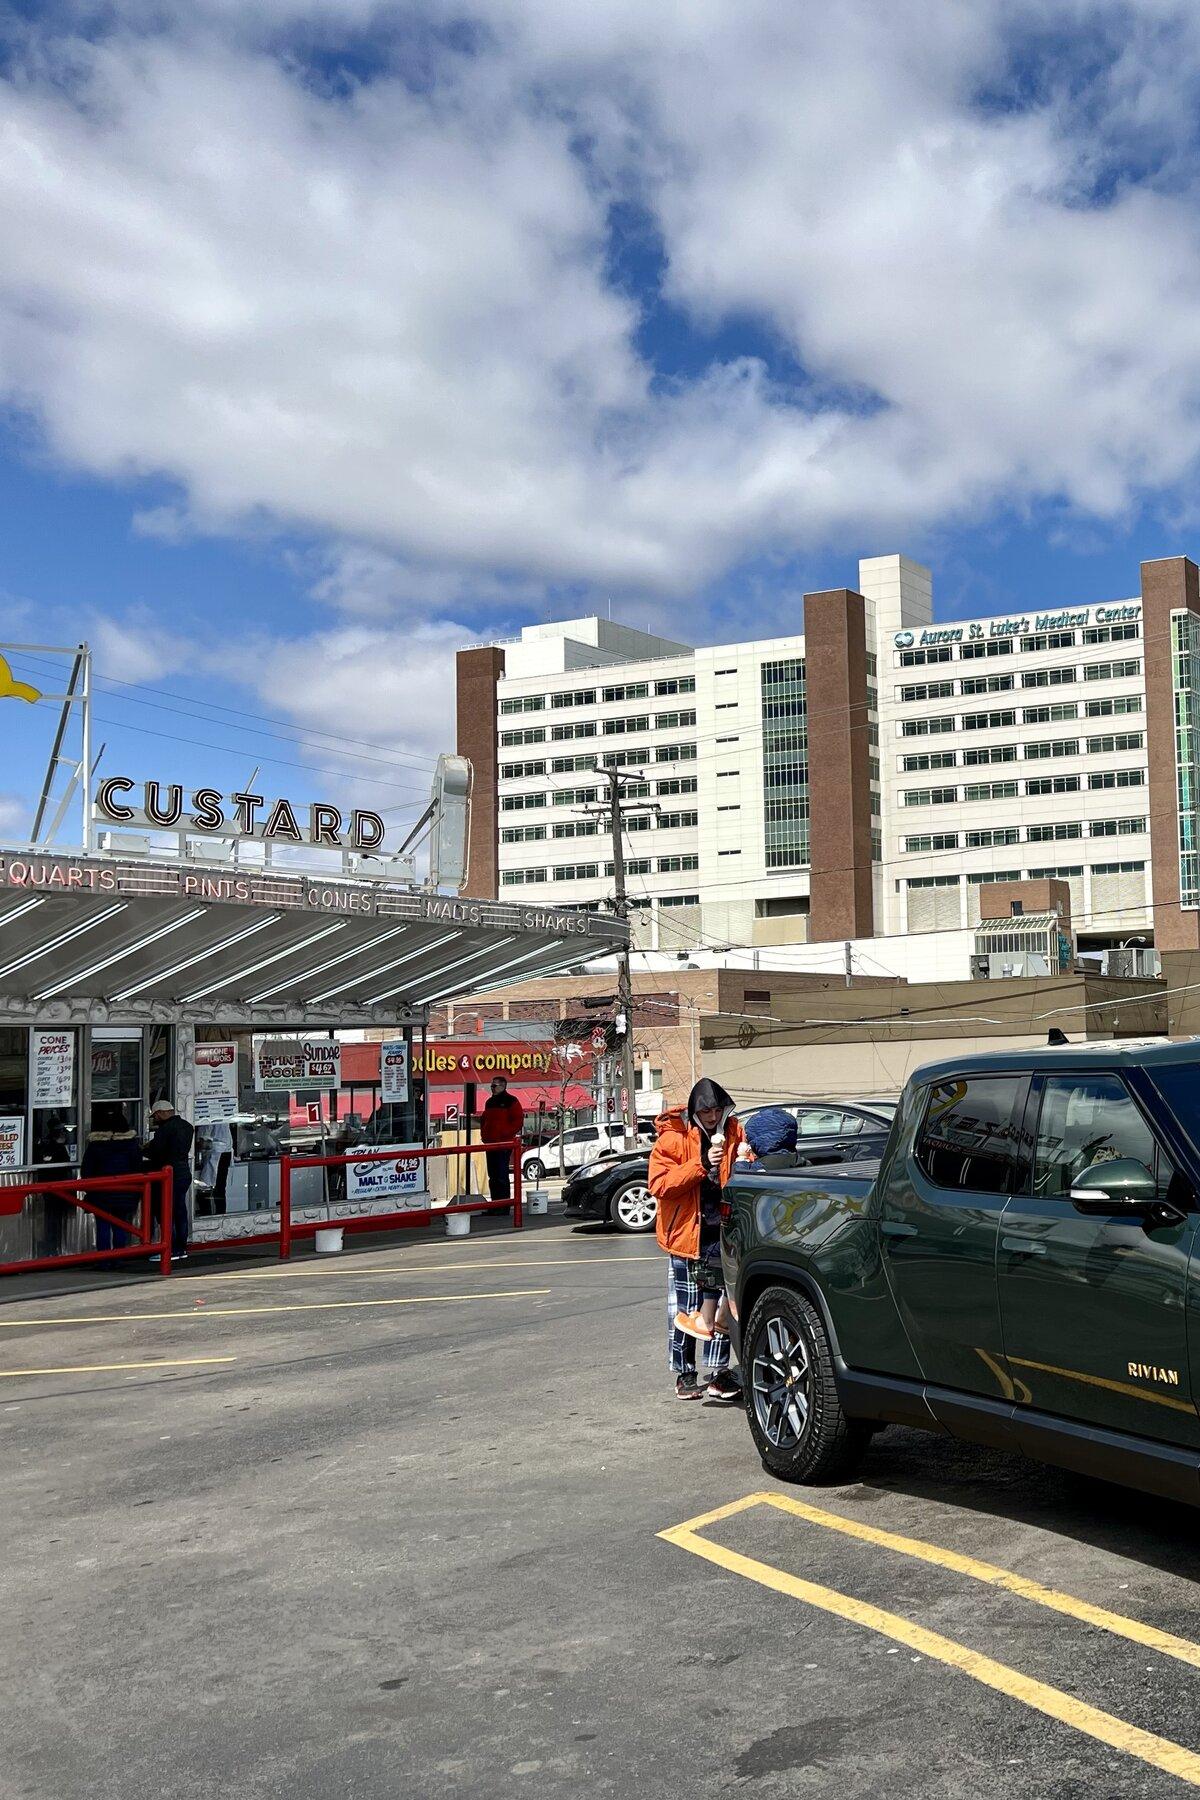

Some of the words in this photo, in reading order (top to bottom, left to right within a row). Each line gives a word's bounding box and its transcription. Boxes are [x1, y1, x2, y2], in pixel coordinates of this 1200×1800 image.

[919, 630, 964, 646] Aurora
[968, 623, 985, 640] St.
[990, 616, 1030, 638] Luke's
[1034, 608, 1090, 632] Medical
[1095, 604, 1142, 624] Center
[97, 776, 385, 849] CUSTARD
[8, 861, 116, 890] QUARTS
[185, 876, 250, 900] PINTS
[308, 888, 372, 912] CONES
[426, 900, 482, 924] MALTS
[524, 911, 587, 934] SHAKES
[40, 1036, 67, 1044] CONE
[38, 1044, 71, 1056] PRICES
[475, 1051, 552, 1075] company
[260, 1067, 302, 1078] ROOF
[311, 1104, 319, 1121] 1
[607, 1098, 615, 1112] 3
[447, 1106, 458, 1121] 2
[358, 1175, 384, 1187] MALT
[389, 1172, 418, 1184] SHAKE
[1127, 1362, 1179, 1386] RIVIAN
